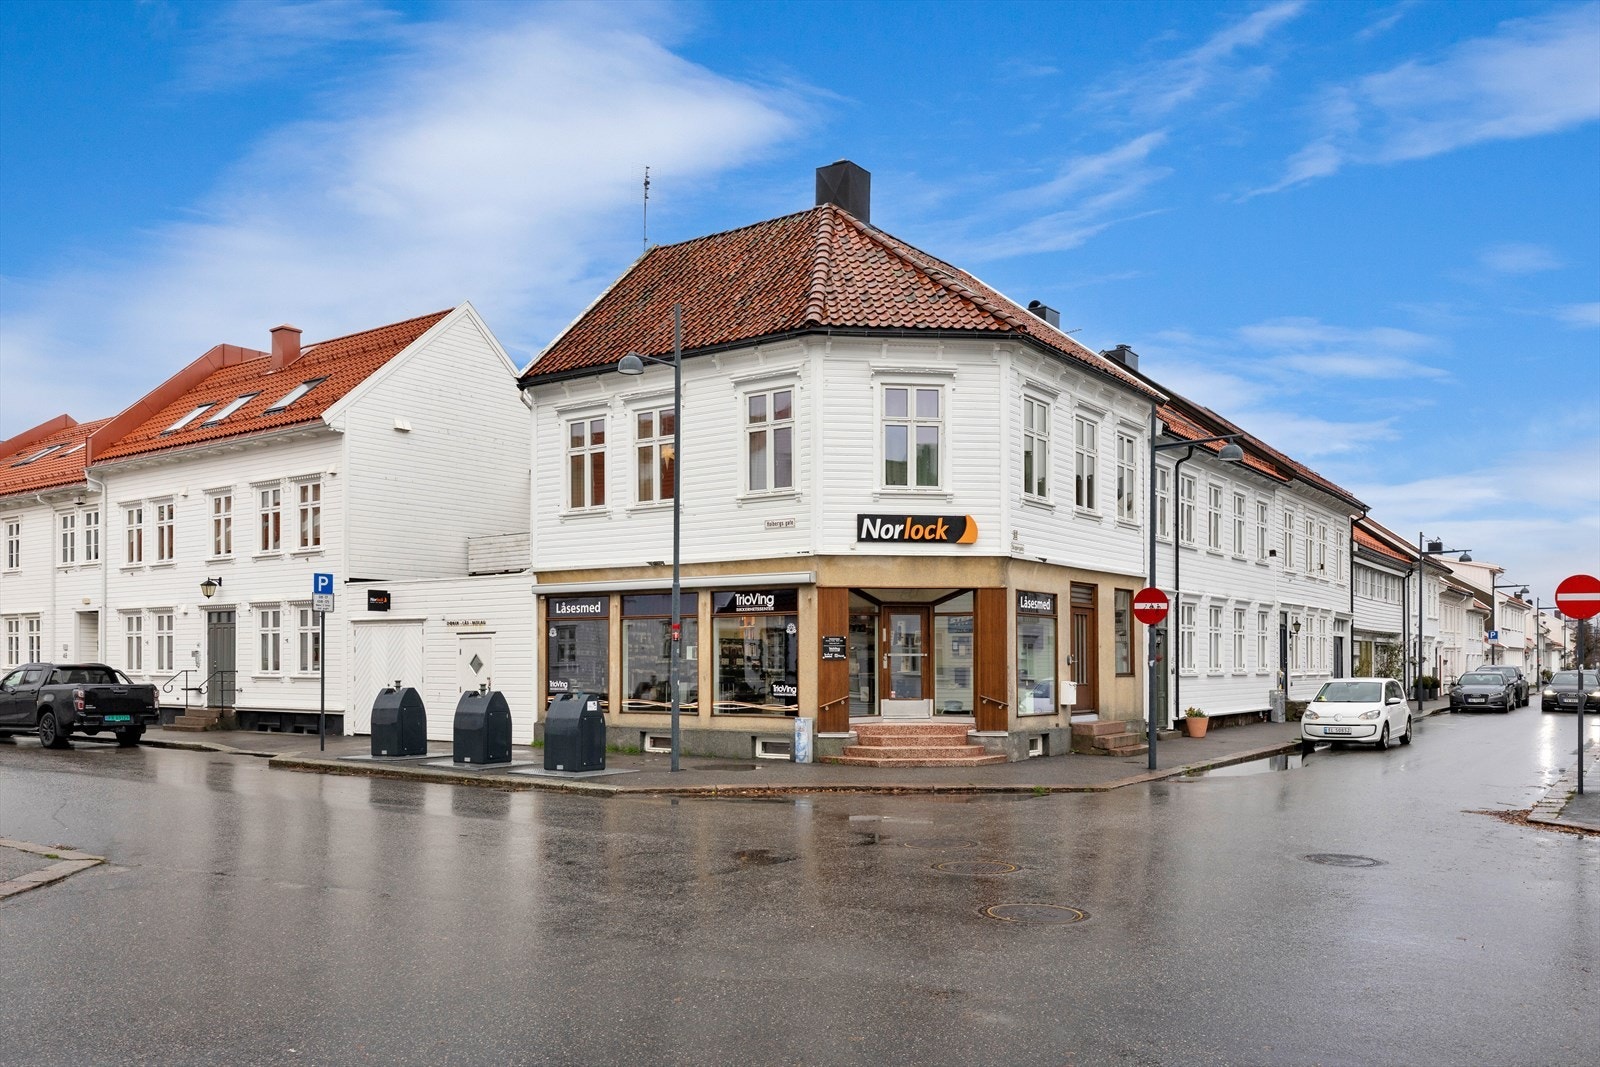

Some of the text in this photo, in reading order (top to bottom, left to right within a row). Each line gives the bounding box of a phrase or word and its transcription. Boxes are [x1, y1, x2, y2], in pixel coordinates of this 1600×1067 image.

[861, 517, 949, 540] Norlock
[318, 576, 329, 591] P
[556, 601, 601, 613] Låsesmed
[735, 593, 774, 607] TrioVing
[1020, 596, 1051, 610] Låsesmed
[550, 680, 568, 689] TrioVing
[773, 685, 796, 695] TrioVing
